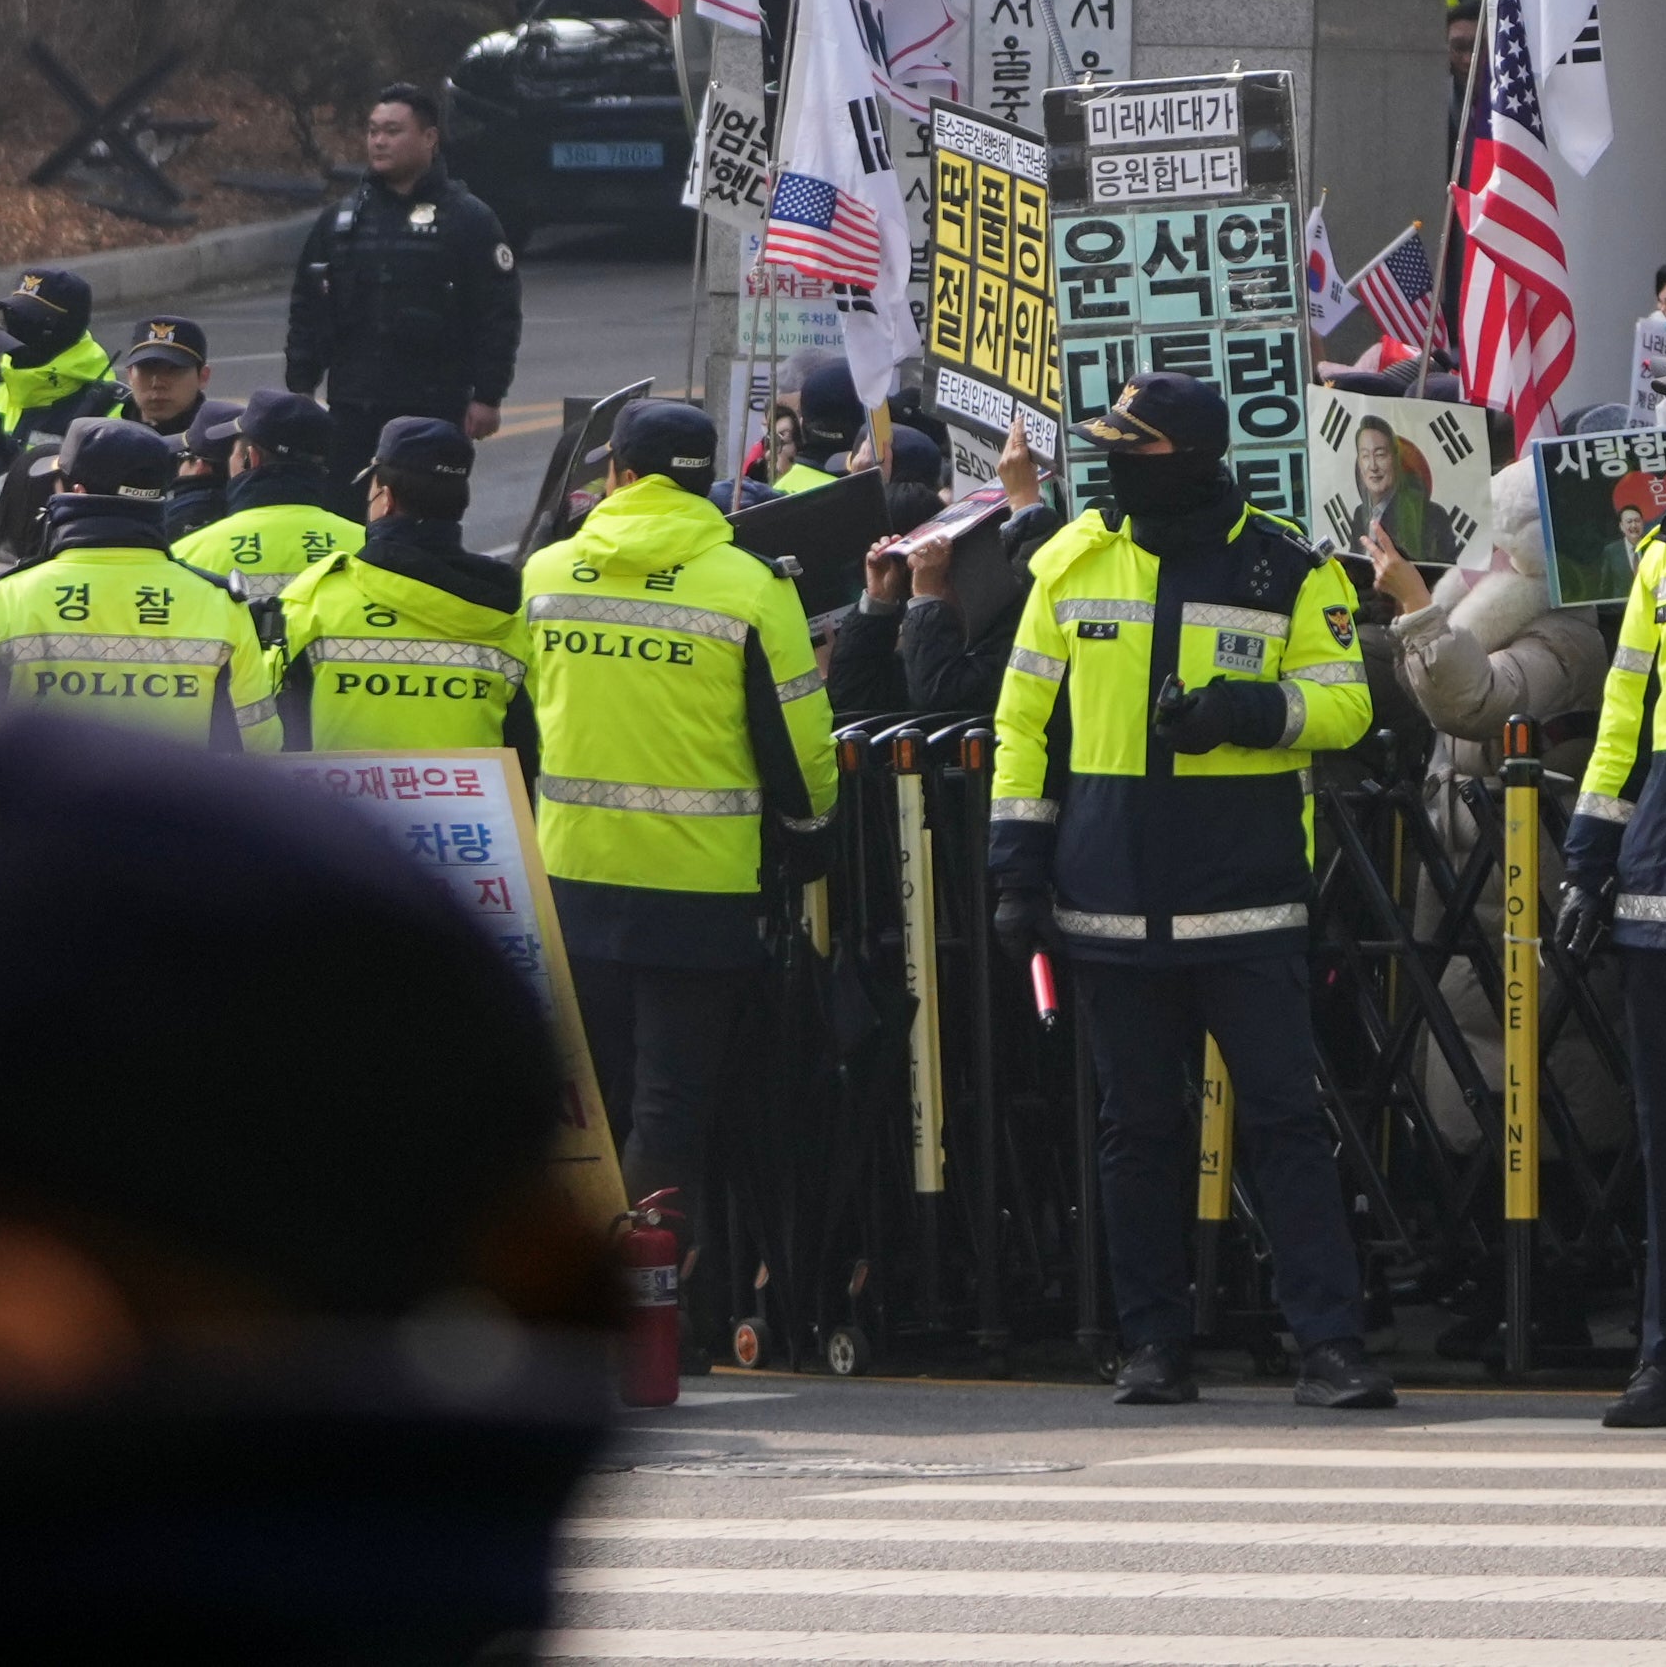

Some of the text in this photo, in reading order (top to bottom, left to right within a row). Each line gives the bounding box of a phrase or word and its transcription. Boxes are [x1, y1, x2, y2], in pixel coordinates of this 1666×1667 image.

[1092, 92, 1234, 139] 미래세대가
[935, 112, 1012, 168] 특수공무집행방해
[1095, 151, 1238, 198] 응원합니다
[1059, 207, 1294, 321] 윤석열
[939, 371, 1011, 430] 무단침입저지는
[436, 464, 467, 475] POLICE
[125, 487, 160, 499] POLICE
[544, 629, 694, 666] POLICE
[1219, 654, 1259, 669] POLICE
[35, 671, 200, 698] POLICE
[335, 672, 493, 700] POLICE
[1506, 865, 1525, 1173] POLICE LINE
